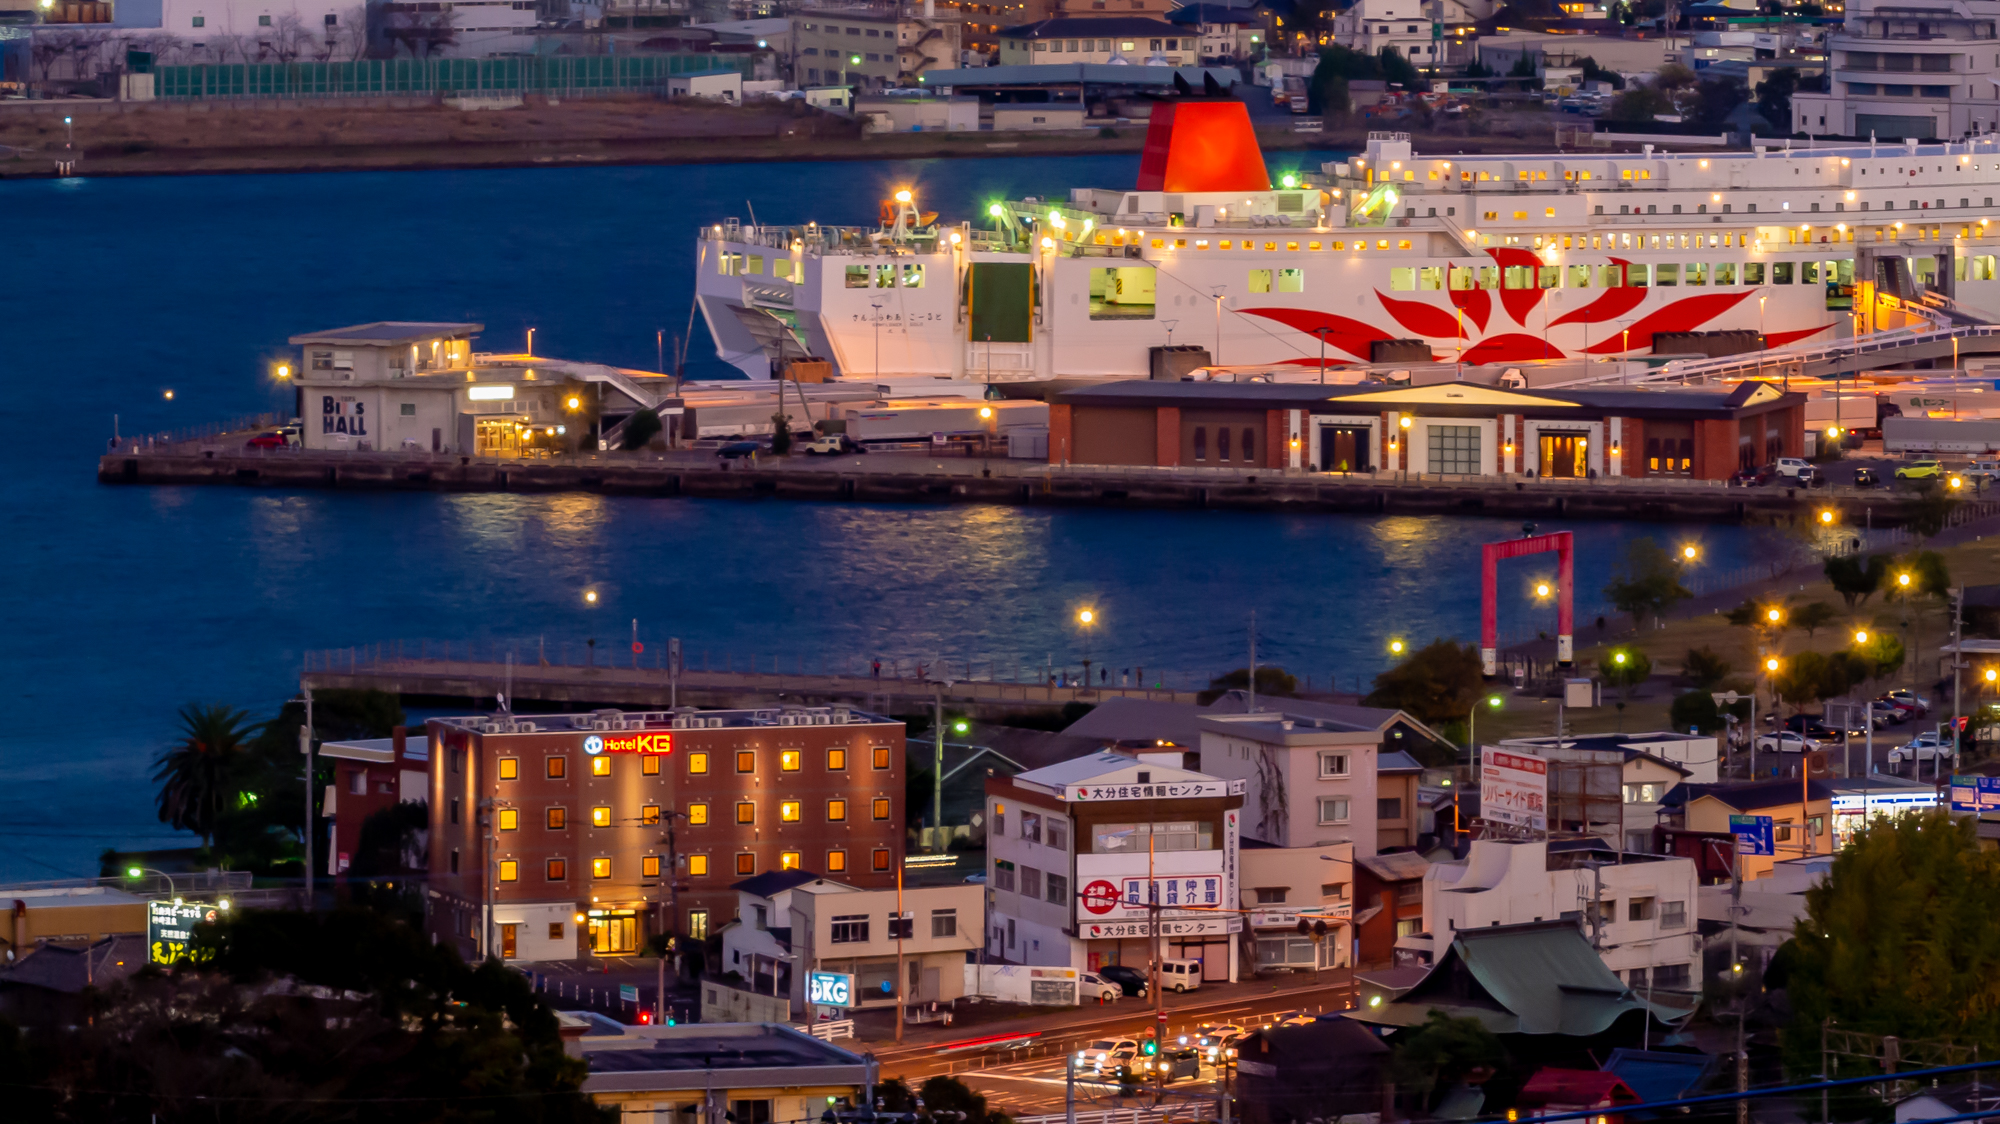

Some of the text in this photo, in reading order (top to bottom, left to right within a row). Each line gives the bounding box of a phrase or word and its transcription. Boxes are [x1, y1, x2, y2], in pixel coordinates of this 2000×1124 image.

[323, 416, 367, 436] HALL
[604, 735, 670, 753] Hotel KG
[1093, 784, 1216, 799] 大分住宅情報センター
